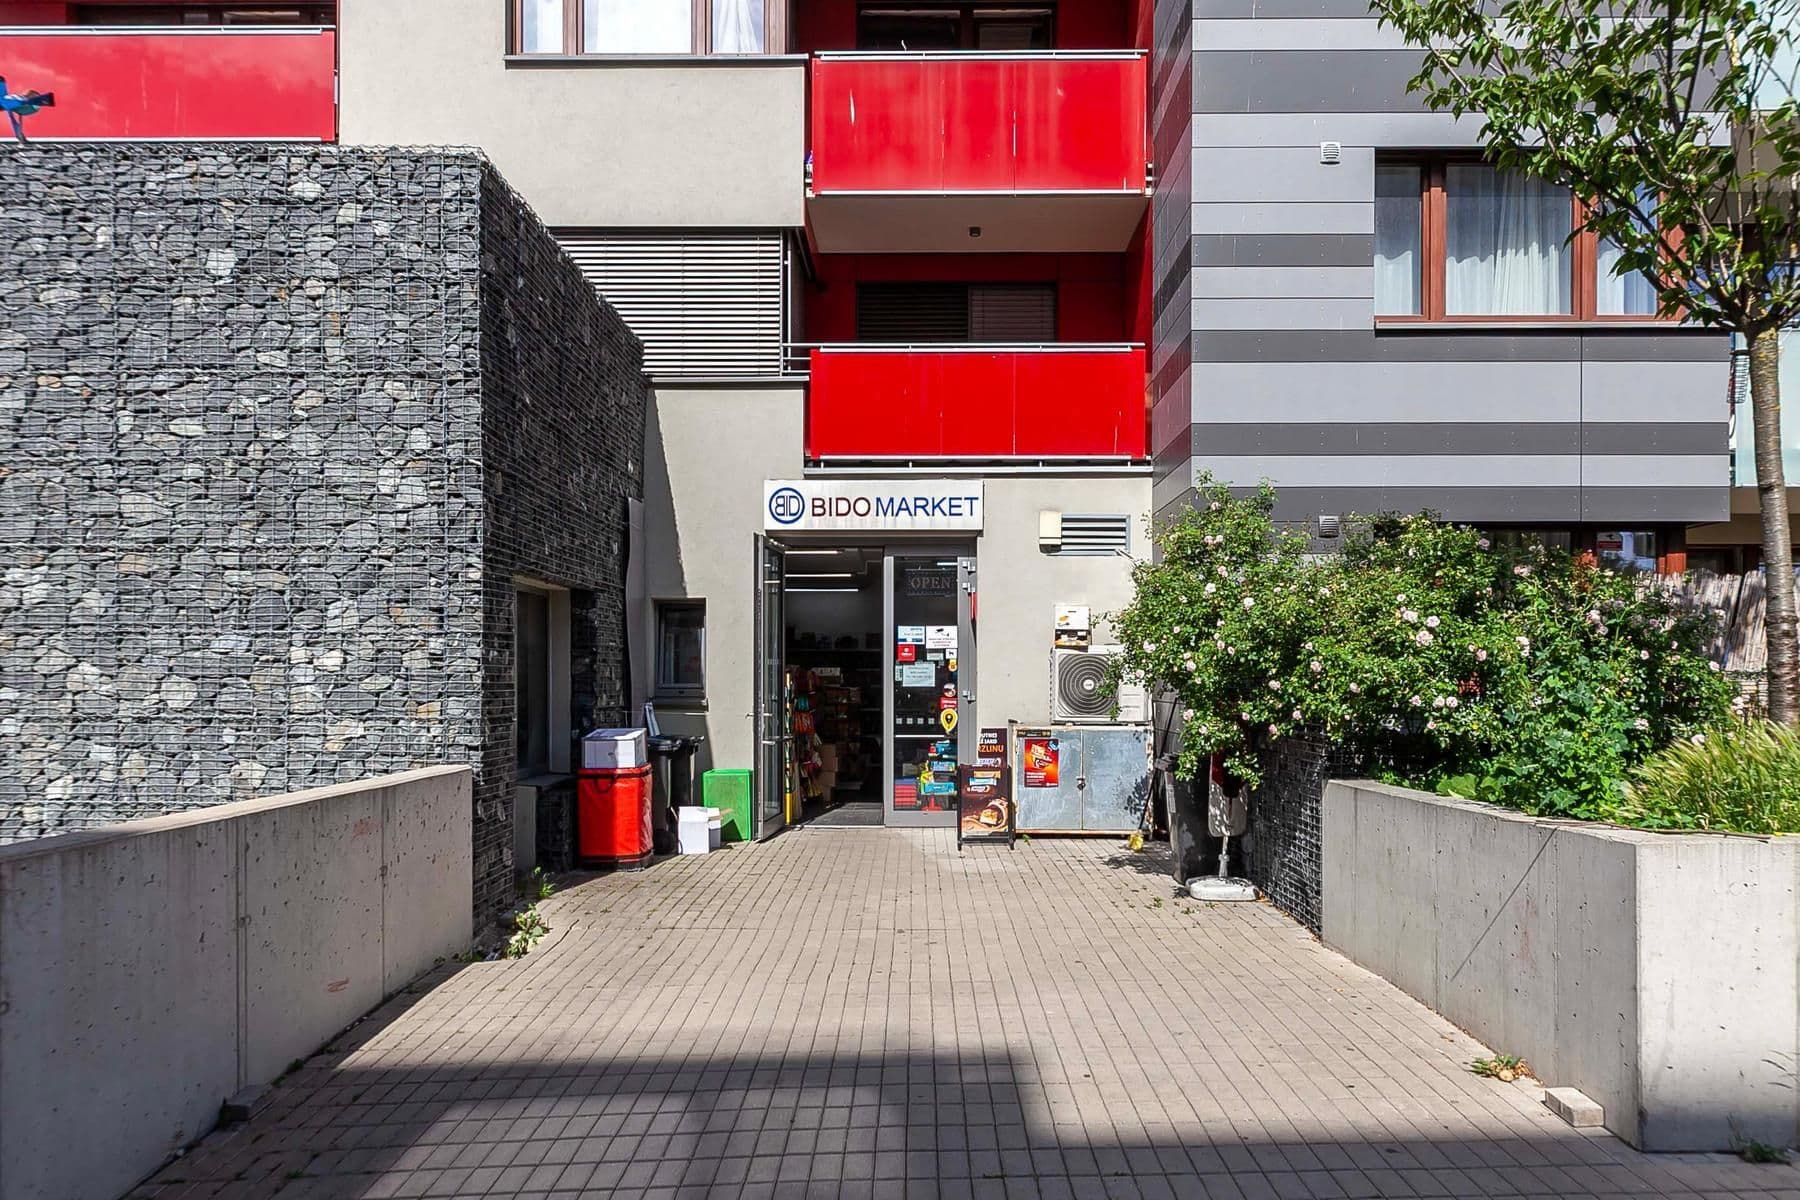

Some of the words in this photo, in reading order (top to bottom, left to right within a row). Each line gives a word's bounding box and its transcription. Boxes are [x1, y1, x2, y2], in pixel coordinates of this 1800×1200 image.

[811, 496, 871, 517] BIDO
[876, 496, 979, 517] MARKET
[911, 576, 951, 589] OPEN
